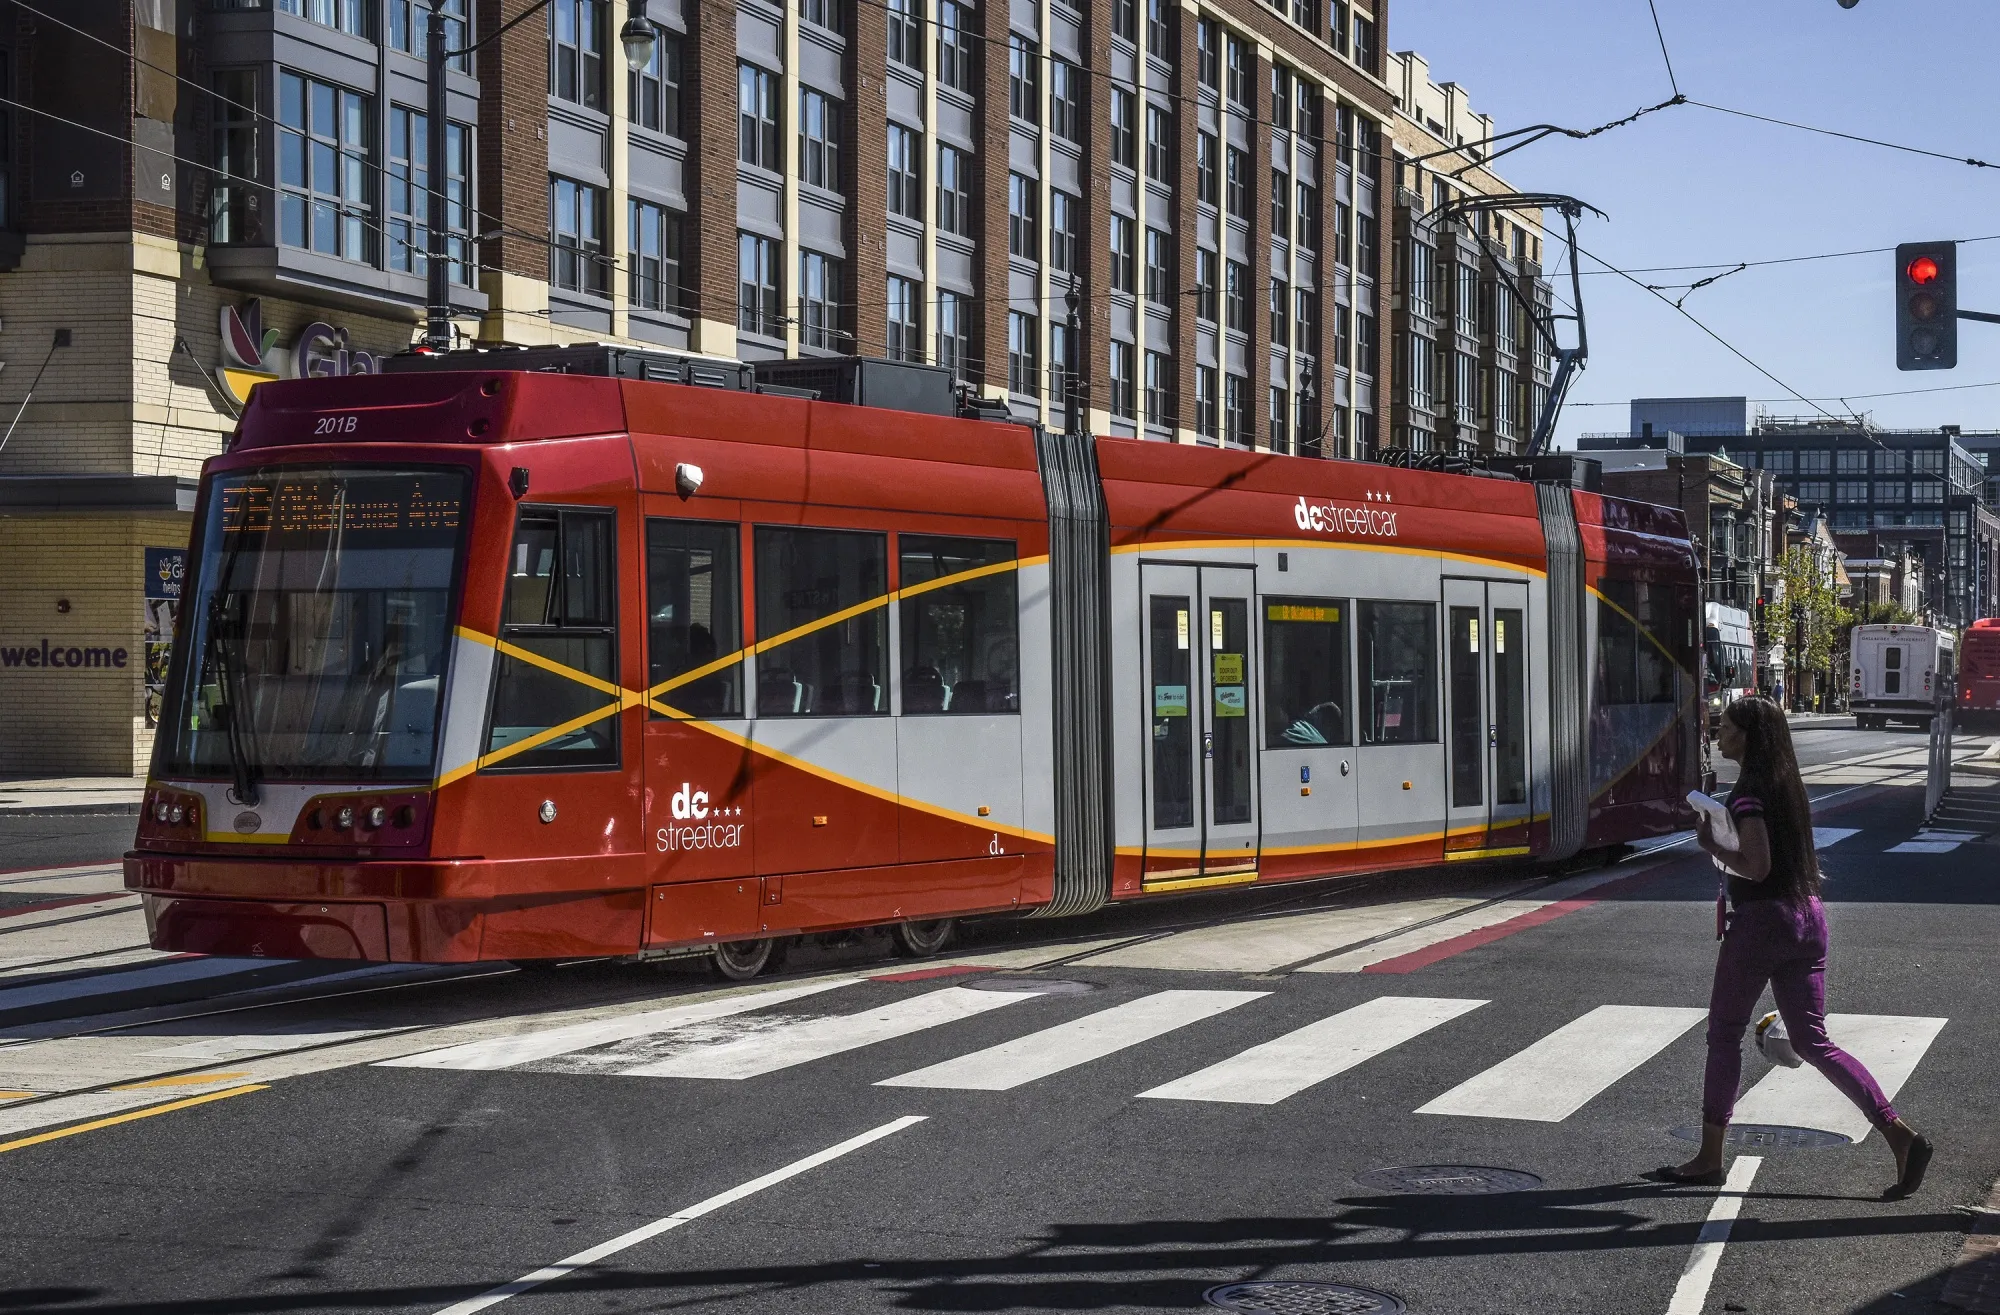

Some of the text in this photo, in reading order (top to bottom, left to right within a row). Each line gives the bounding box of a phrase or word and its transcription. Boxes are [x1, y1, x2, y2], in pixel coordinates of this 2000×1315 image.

[291, 322, 384, 378] Gia
[314, 416, 358, 435] 201B
[280, 485, 398, 531] Oklahoma
[408, 482, 460, 528] Ave
[162, 581, 181, 596] helps
[0, 638, 128, 668] welcome
[671, 782, 709, 820] dc
[656, 819, 745, 852] streetcar
[989, 832, 1005, 855] d.
